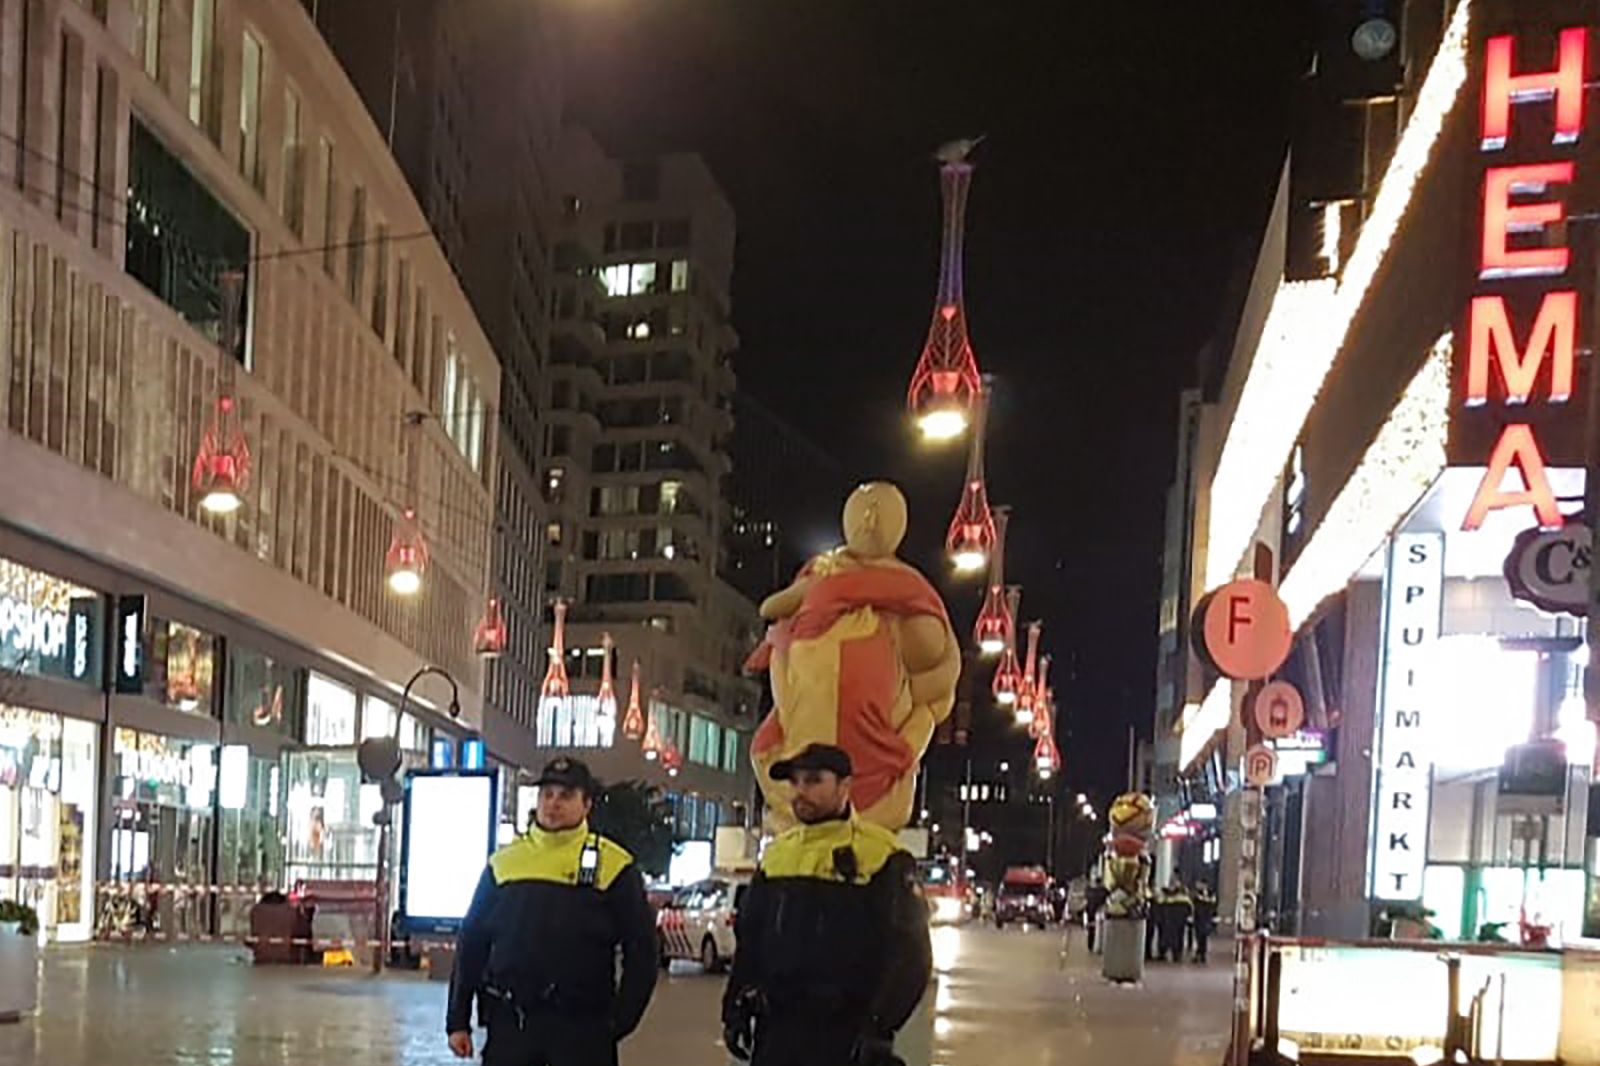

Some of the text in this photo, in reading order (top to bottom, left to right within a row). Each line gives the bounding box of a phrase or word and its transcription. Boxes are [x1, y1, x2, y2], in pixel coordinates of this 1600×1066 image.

[1461, 27, 1588, 531] HEMA
[1229, 596, 1252, 644] F
[1388, 543, 1428, 892] SPUIMARKT
